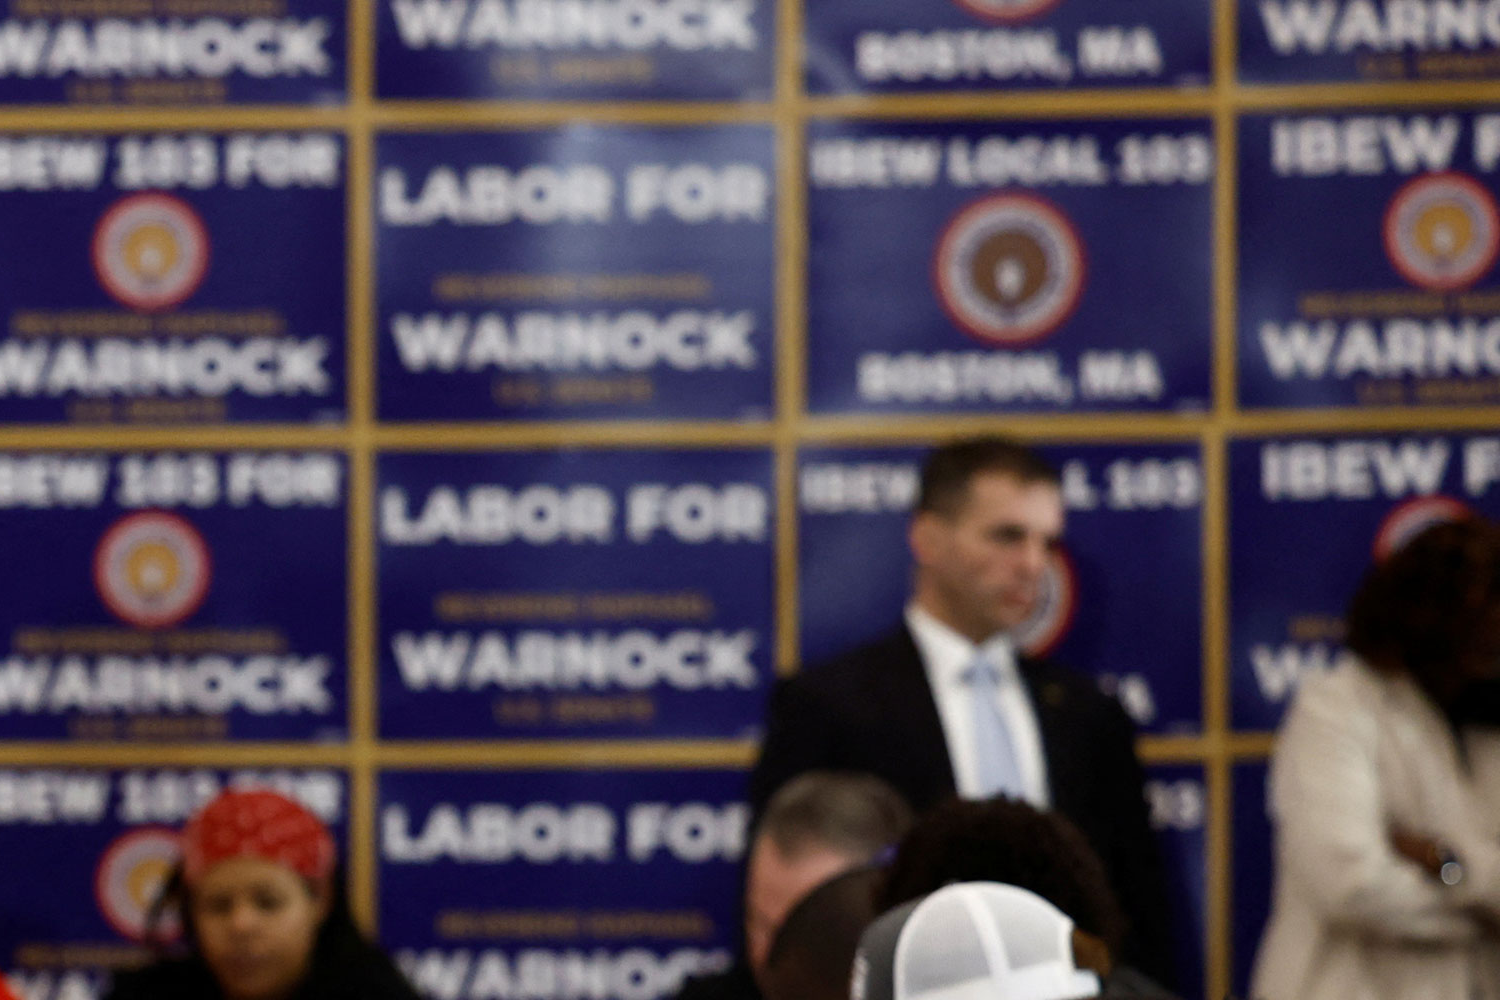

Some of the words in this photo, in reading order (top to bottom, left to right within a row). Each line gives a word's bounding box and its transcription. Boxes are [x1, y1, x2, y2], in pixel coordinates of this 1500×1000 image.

[390, 0, 756, 50] WARNOCK
[1078, 27, 1161, 73] MA
[116, 136, 219, 189] 103
[227, 136, 340, 187] FOR
[810, 140, 940, 189] IBEW
[1115, 134, 1212, 184] 103
[1271, 117, 1459, 176] IBEW
[380, 166, 614, 224] LABOR
[626, 164, 768, 222] FOR
[393, 310, 758, 370] WARNOCK
[1257, 319, 1500, 379] WARN
[1078, 352, 1162, 398] MA
[118, 455, 217, 507] 103
[228, 454, 340, 506] FOR
[1106, 459, 1198, 509] 103
[1261, 440, 1449, 500] IBEW
[381, 483, 614, 544] LABOR
[626, 483, 767, 542] FOR
[394, 630, 756, 690] WARNOCK
[381, 804, 617, 862] LABOR
